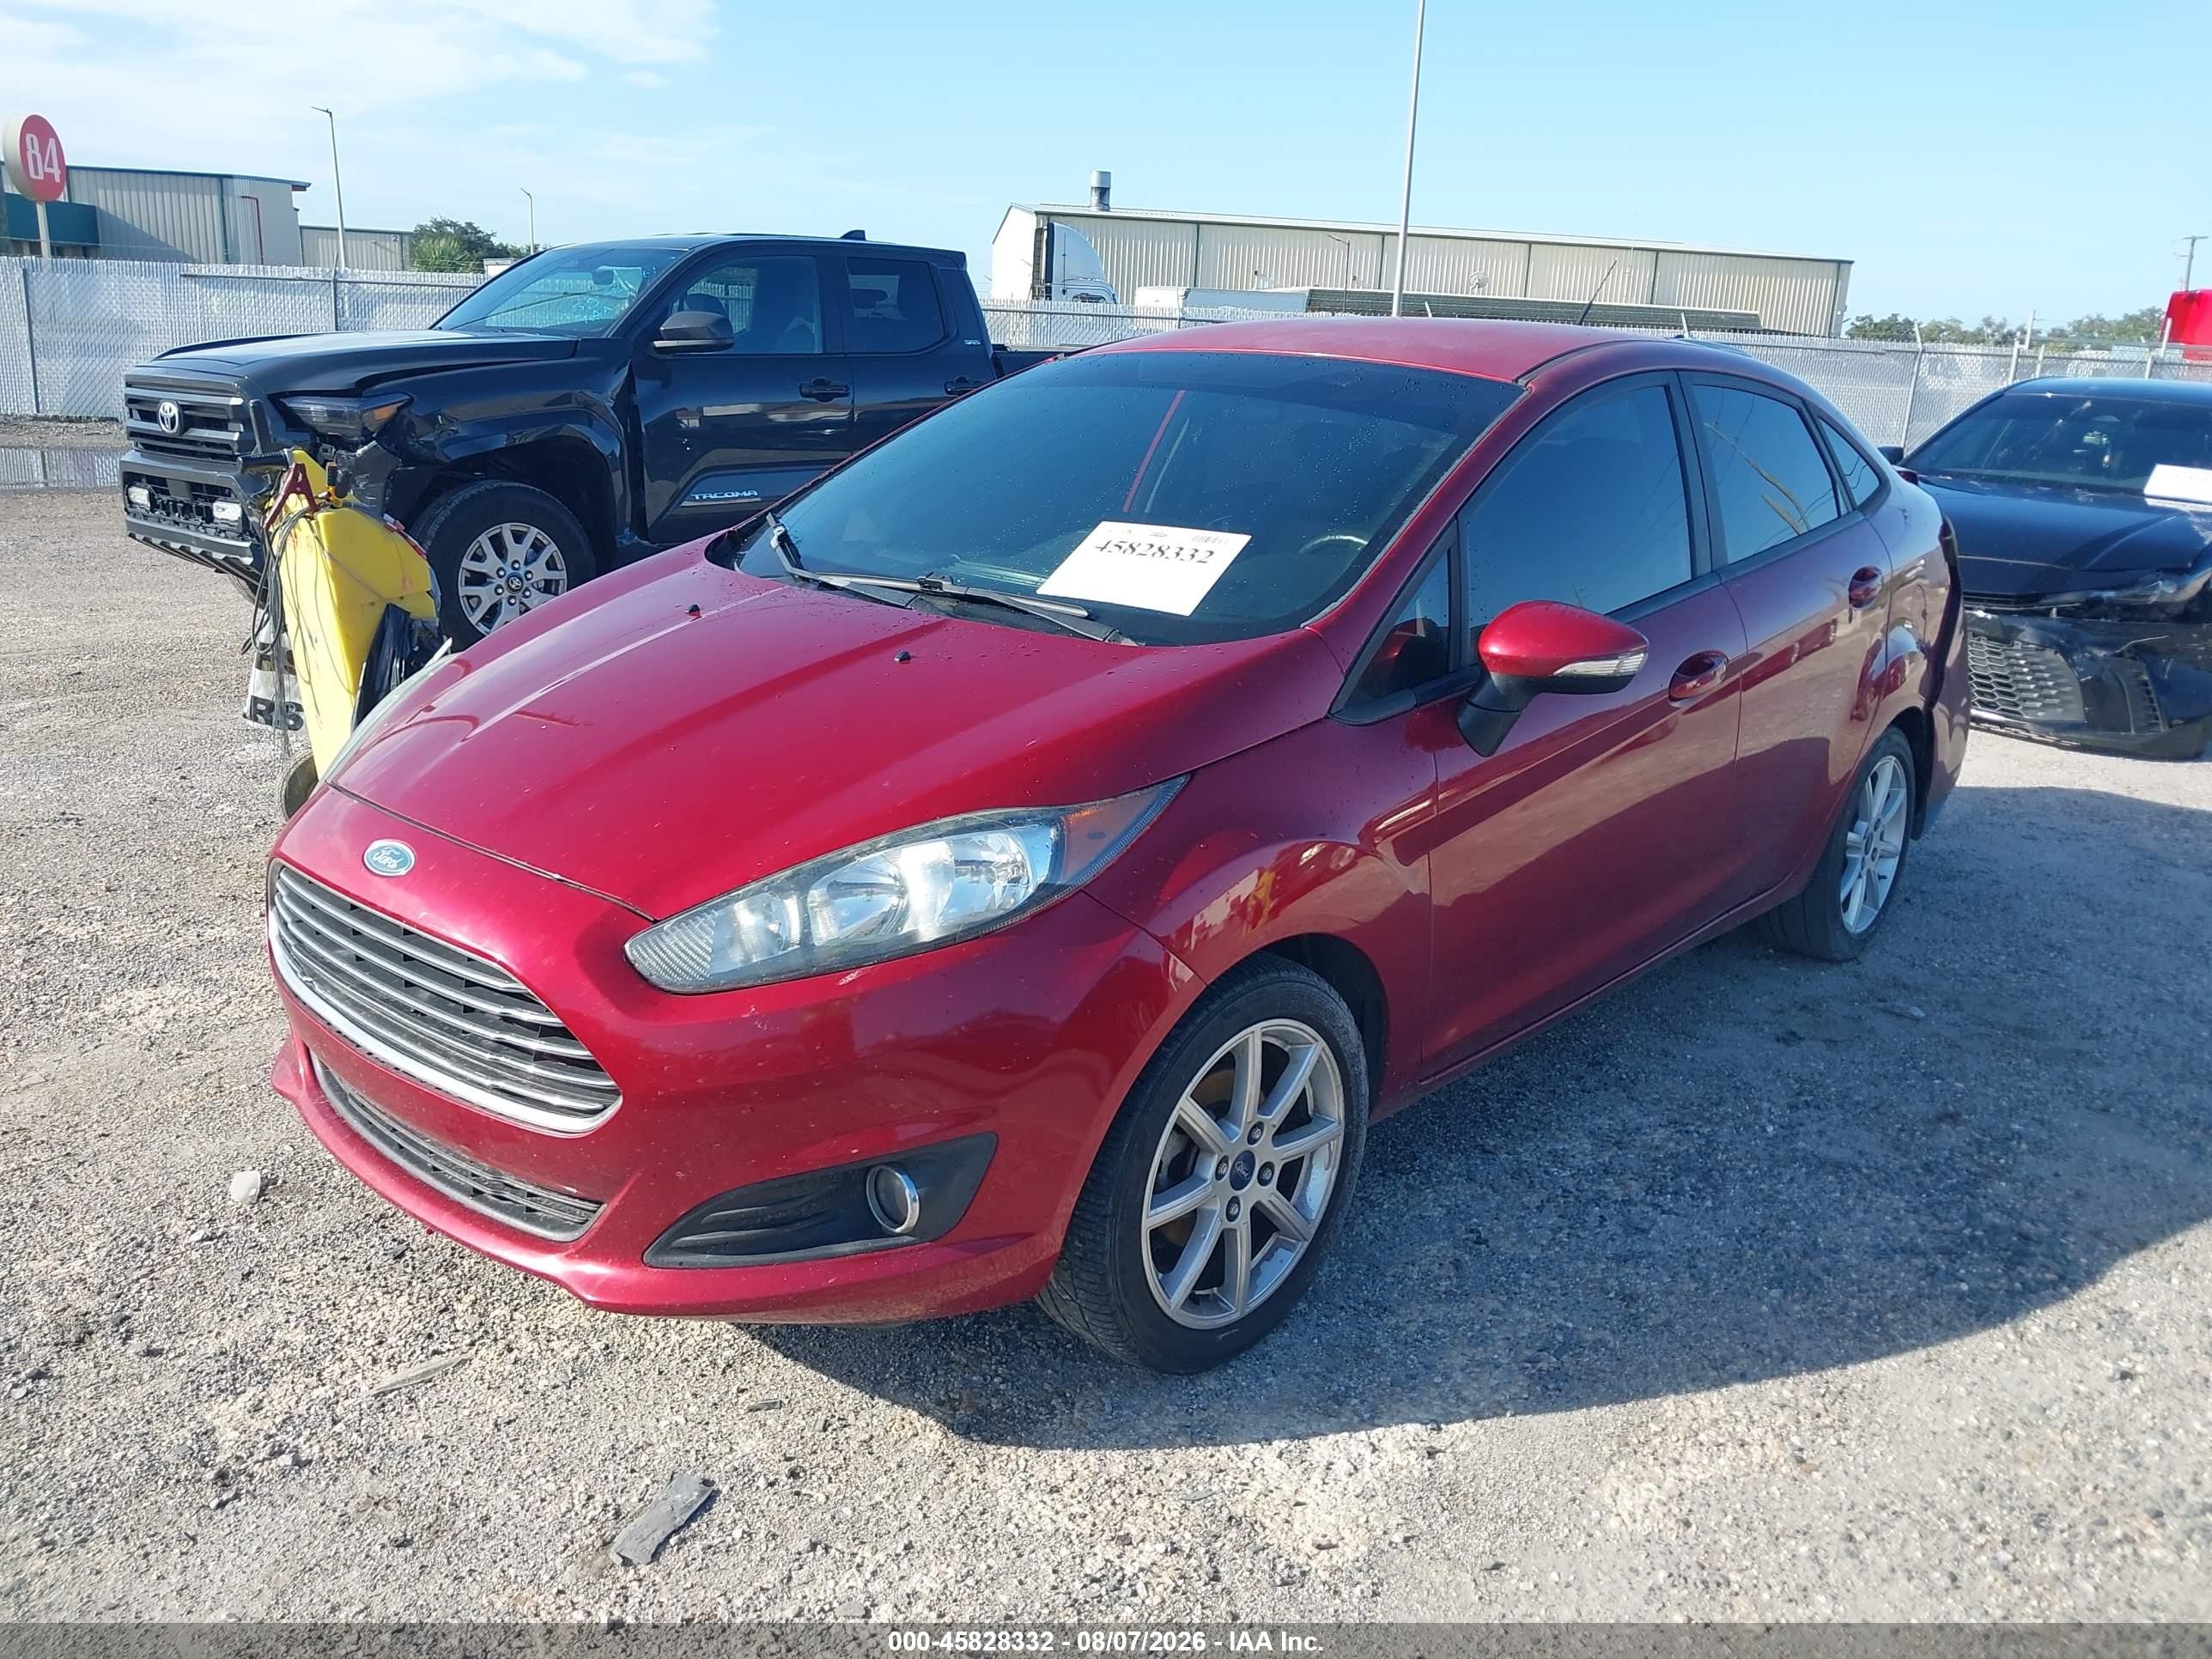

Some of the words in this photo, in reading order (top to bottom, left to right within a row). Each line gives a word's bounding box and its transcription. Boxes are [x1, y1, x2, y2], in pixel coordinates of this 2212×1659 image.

[26, 133, 61, 183] 84
[690, 490, 758, 500] TACOMA
[1095, 540, 1215, 564] 45828332
[372, 846, 404, 869] Ford
